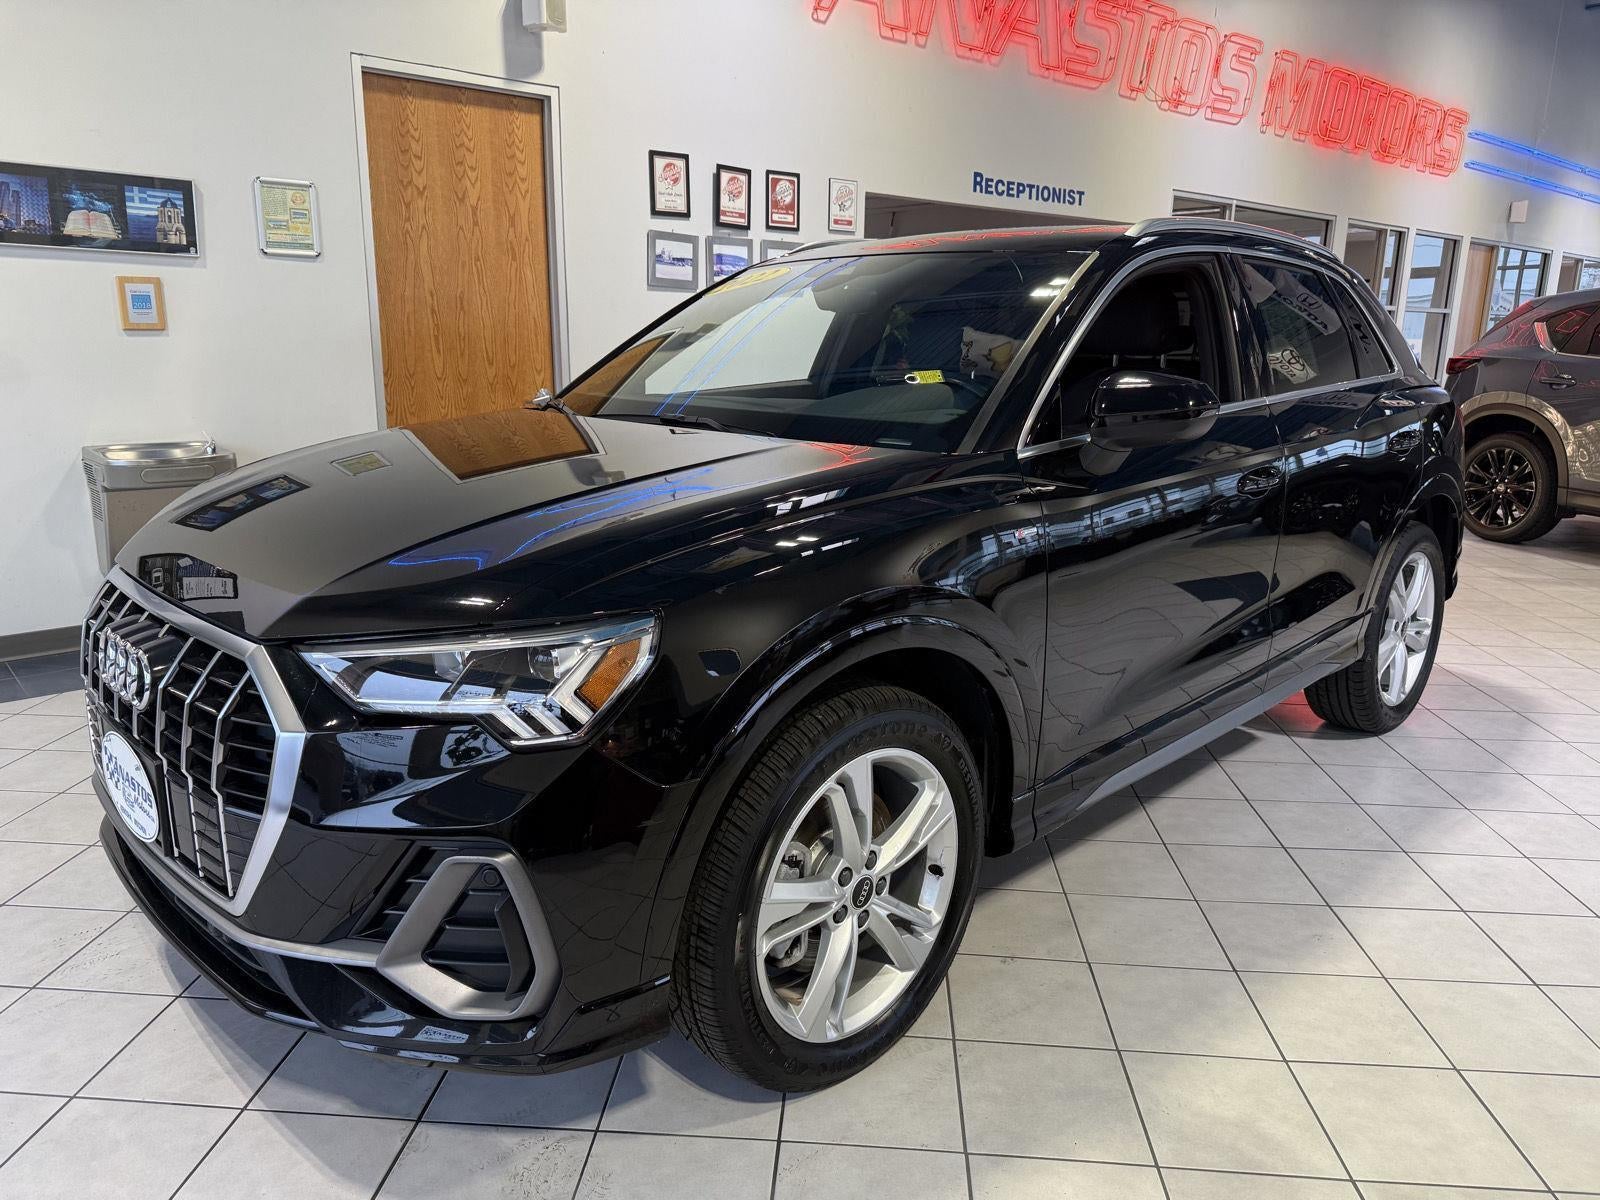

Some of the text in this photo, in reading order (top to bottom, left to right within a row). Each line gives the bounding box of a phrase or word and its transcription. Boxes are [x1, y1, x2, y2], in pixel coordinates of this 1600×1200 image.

[811, 0, 1469, 176] ASTOS MOTORS
[972, 171, 1085, 206] RECEPTIONIST
[1268, 355, 1297, 378] OYOTA
[112, 757, 154, 809] ANASTOS
